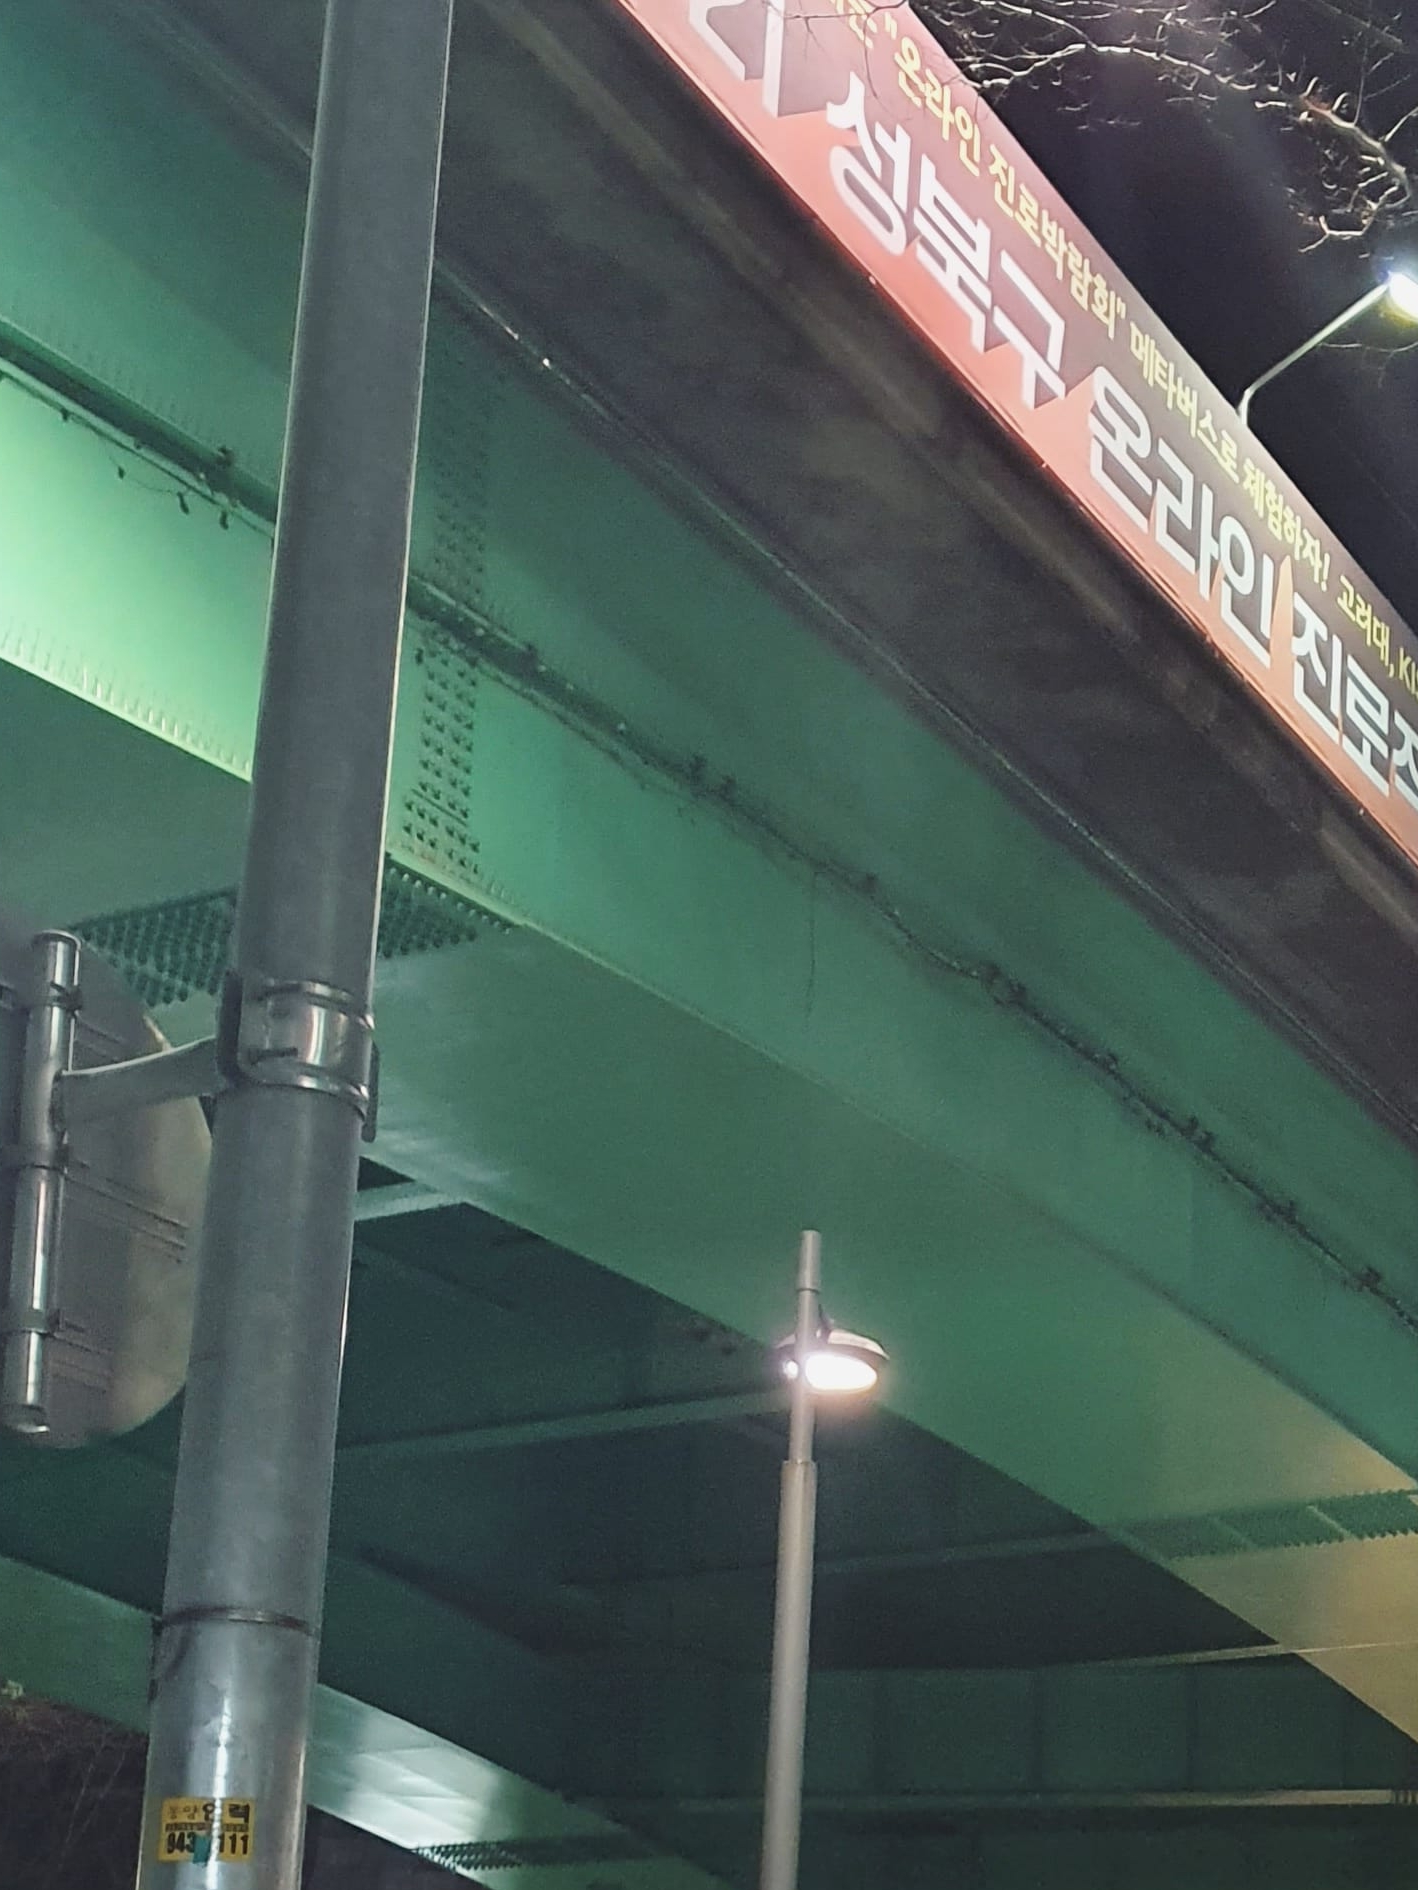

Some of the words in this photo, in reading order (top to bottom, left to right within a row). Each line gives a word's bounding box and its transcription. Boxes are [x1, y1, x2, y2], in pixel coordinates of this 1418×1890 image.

[826, 71, 1066, 409] 성북구
[1088, 366, 1274, 669] 온라인
[1130, 322, 1241, 484] 메타버스로
[1242, 459, 1330, 592] 체험하자!
[1337, 575, 1394, 678] 고려대,
